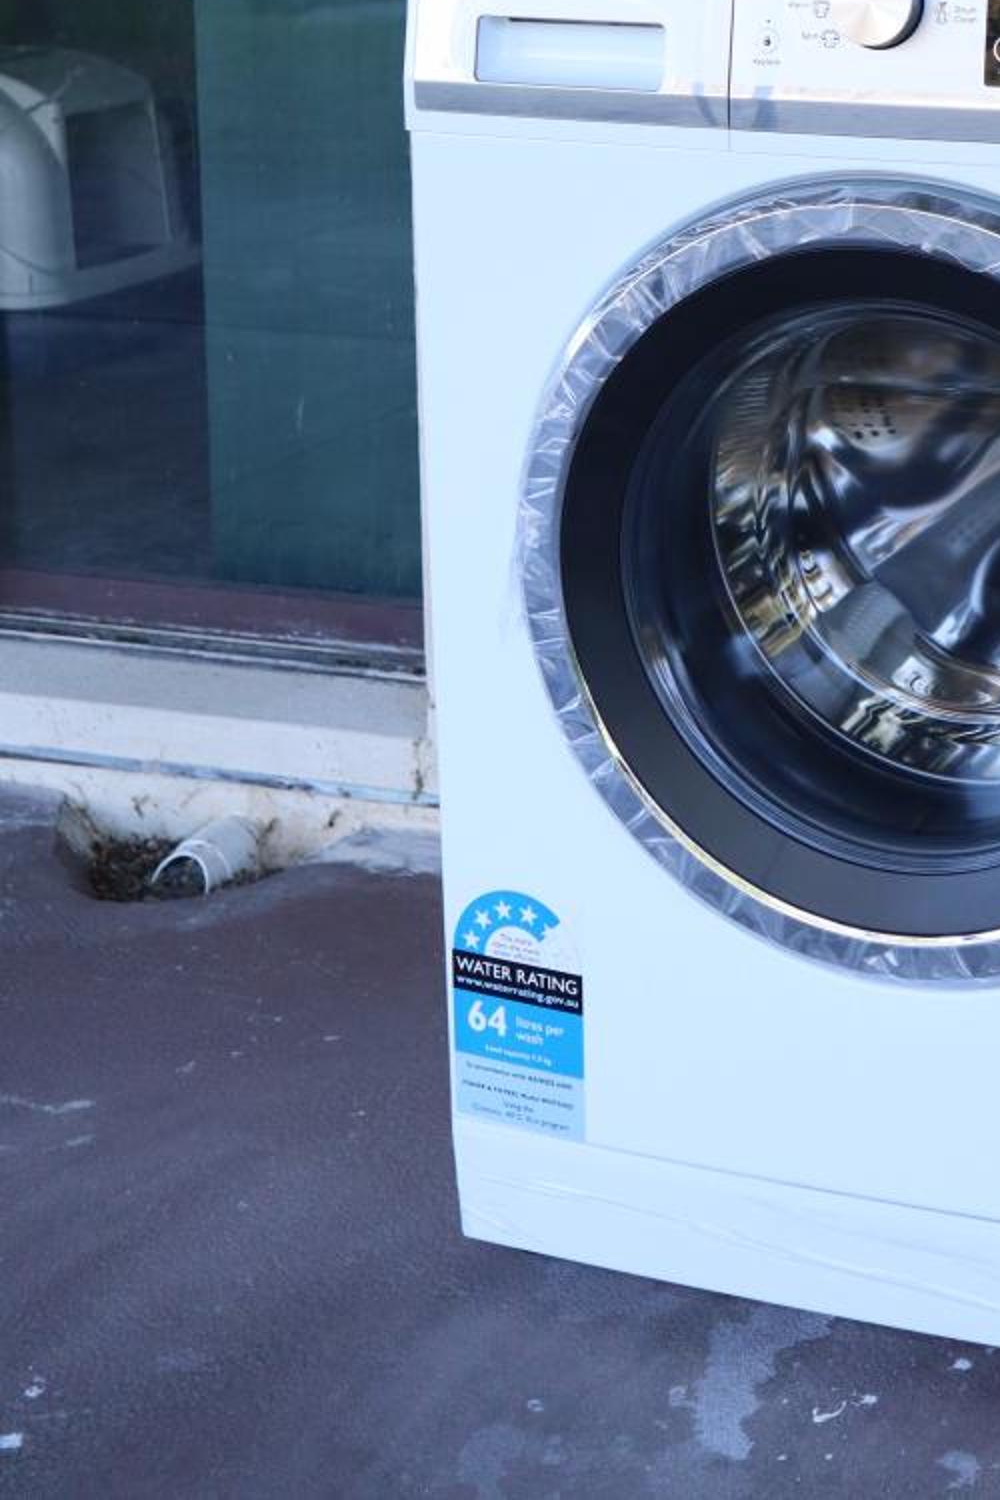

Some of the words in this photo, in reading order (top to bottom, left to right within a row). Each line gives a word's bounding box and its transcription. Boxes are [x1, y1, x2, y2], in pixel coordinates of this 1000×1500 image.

[456, 955, 512, 982] WATER
[516, 969, 578, 996] RATING
[456, 975, 580, 1008] www.waterrating.gov.au
[467, 1000, 507, 1037] 64
[515, 1032, 544, 1045] wash
